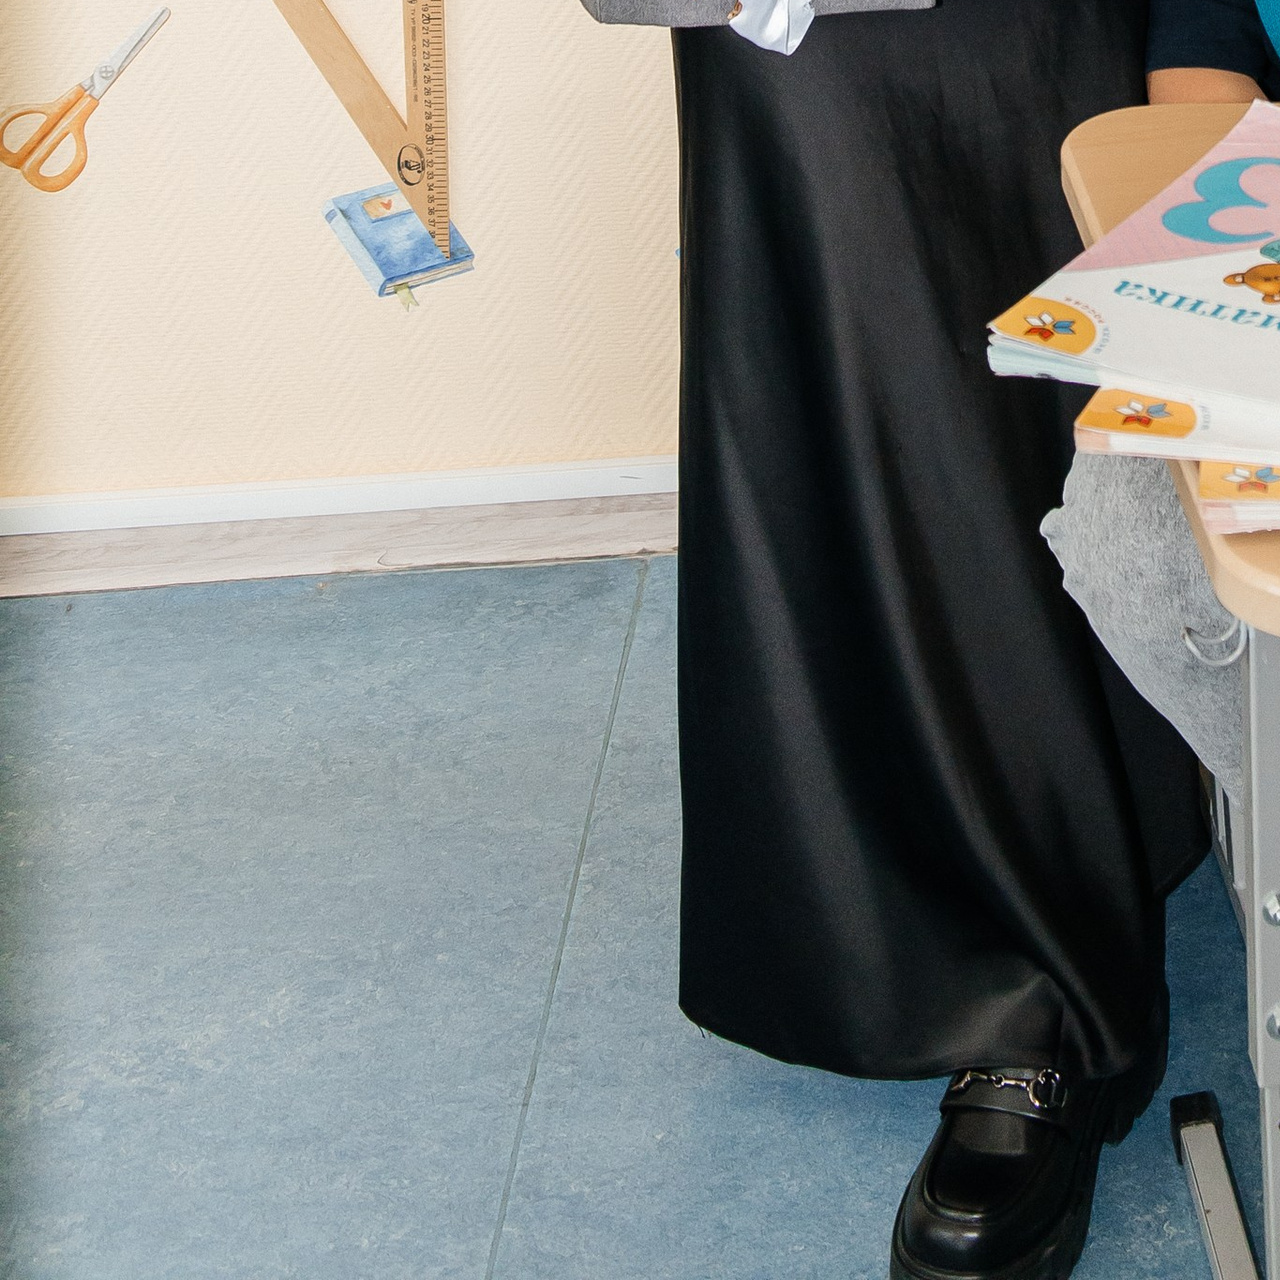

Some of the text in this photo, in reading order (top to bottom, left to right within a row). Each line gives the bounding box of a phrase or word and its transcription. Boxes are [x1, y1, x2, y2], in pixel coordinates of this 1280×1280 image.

[421, 4, 428, 12] 19
[422, 13, 430, 24] 20
[422, 27, 429, 35] 21
[422, 39, 429, 47] 22
[423, 51, 430, 59] 23
[424, 63, 430, 71] 24
[424, 75, 431, 84] 25
[425, 87, 432, 96] 26
[425, 99, 432, 108] 27
[425, 111, 432, 120] 28
[425, 123, 432, 132] 29
[426, 134, 434, 145] 30
[426, 147, 433, 155] 31
[427, 159, 433, 168] 32
[427, 171, 434, 180] 33
[427, 183, 434, 191] 34
[428, 195, 435, 203] 35
[428, 207, 435, 215] 36
[428, 219, 435, 227] 37
